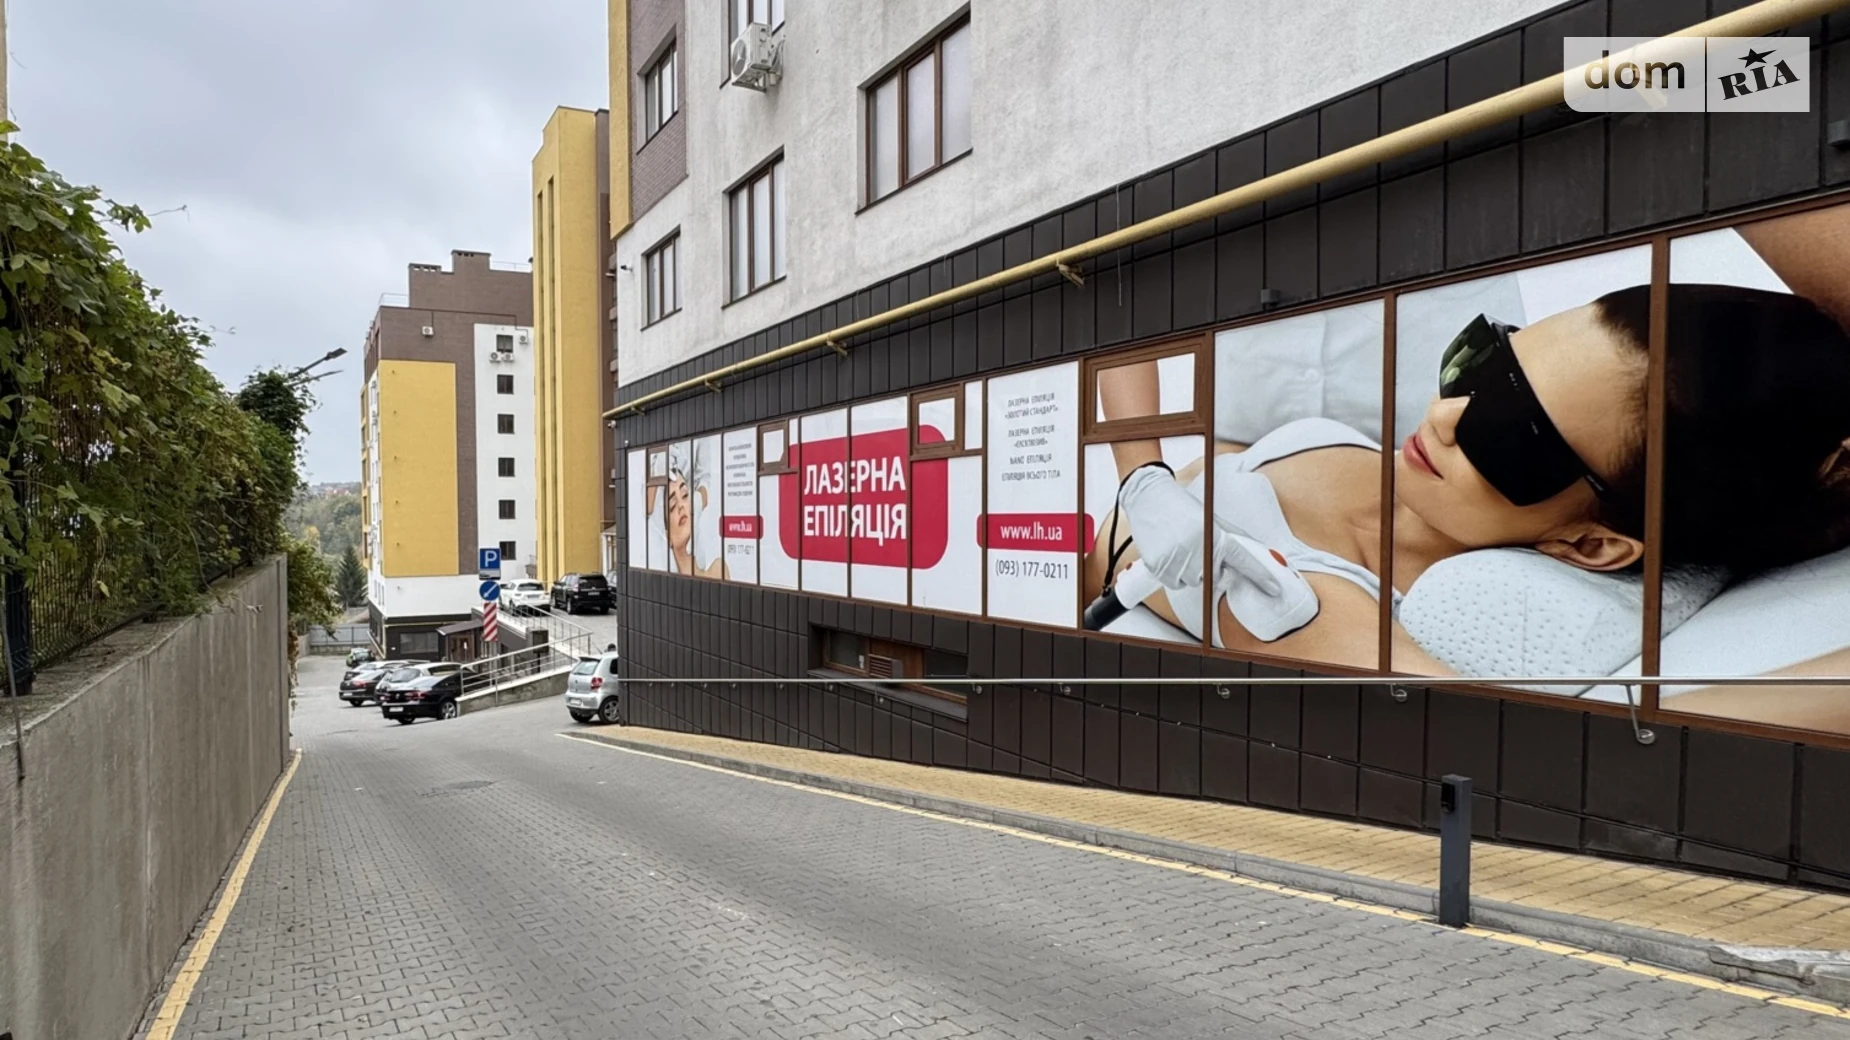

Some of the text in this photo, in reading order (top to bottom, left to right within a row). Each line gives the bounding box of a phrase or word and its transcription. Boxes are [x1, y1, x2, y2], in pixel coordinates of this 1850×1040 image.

[804, 456, 906, 495] ЛАЗЕРНА
[804, 503, 906, 547] ЕПІЛЯЦІЯ
[1000, 521, 1063, 541] www.lh.ua
[484, 550, 498, 568] P
[995, 559, 1068, 580] (093) 177-0211
